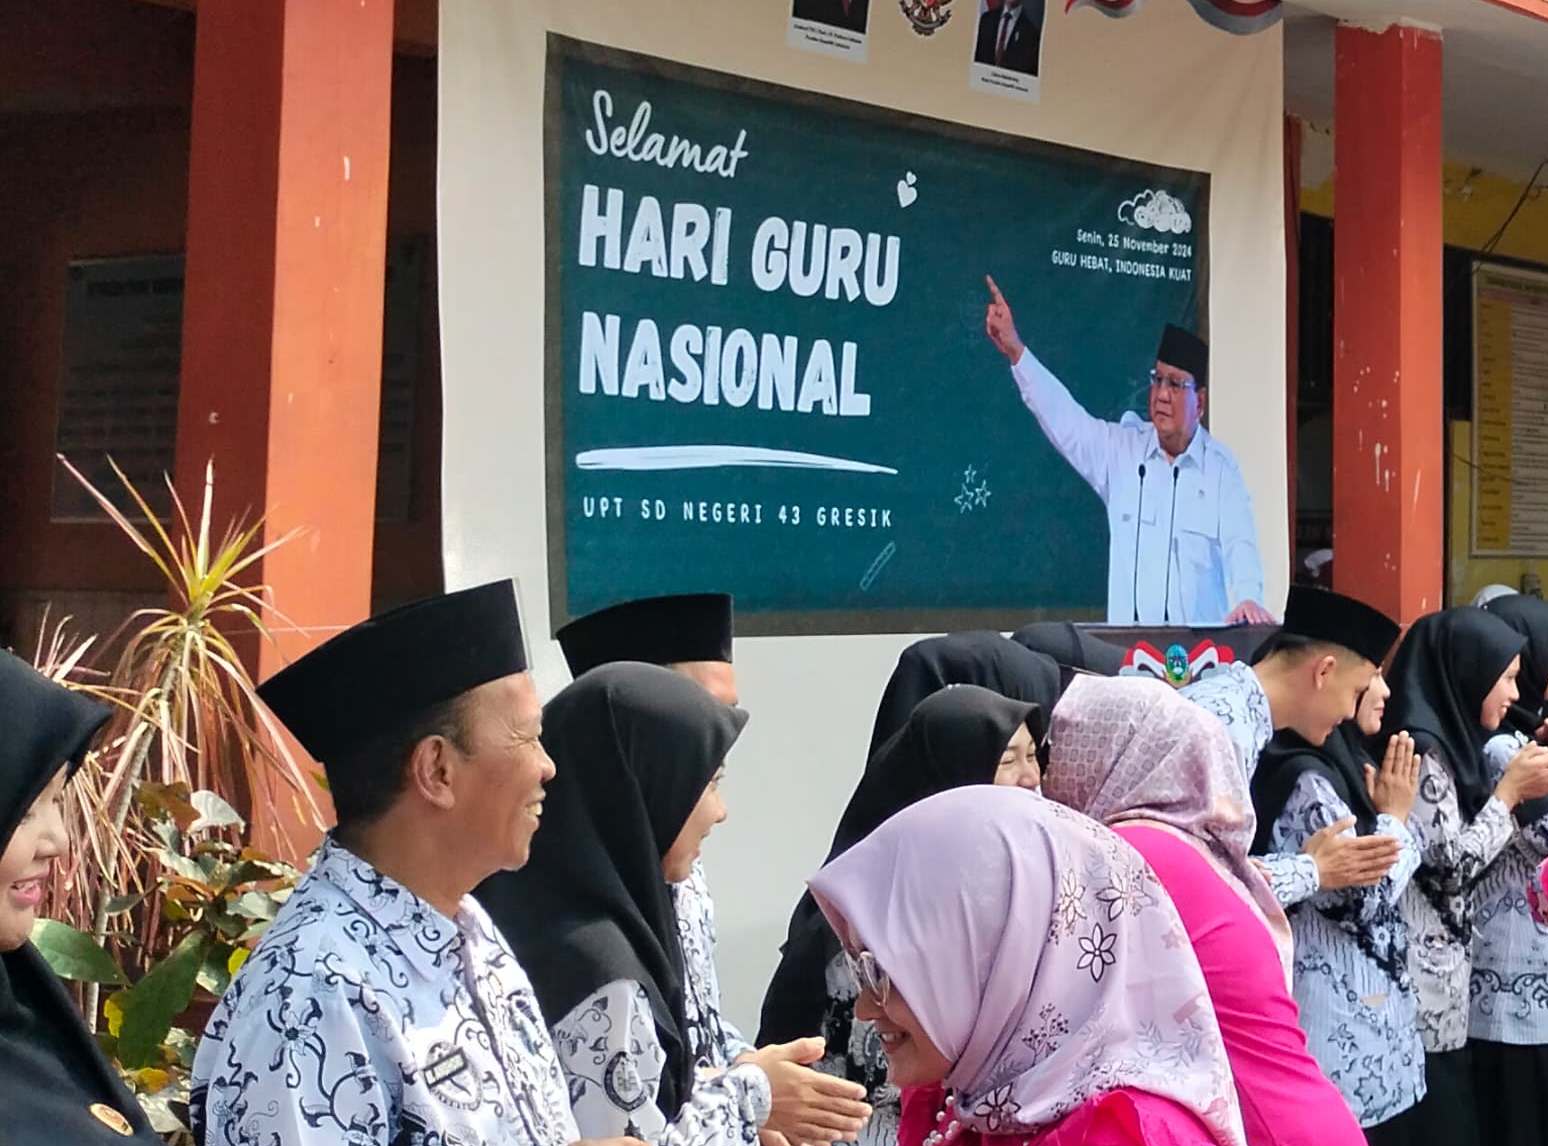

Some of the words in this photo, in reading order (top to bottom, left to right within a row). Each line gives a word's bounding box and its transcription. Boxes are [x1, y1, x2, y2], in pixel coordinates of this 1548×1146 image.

[586, 90, 748, 178] Selamat
[578, 184, 732, 286] HARI
[751, 216, 901, 307] GURU
[1052, 250, 1077, 266] GURU
[1080, 254, 1113, 273] HEBAT,
[1116, 259, 1166, 278] INDONESIA
[1168, 267, 1192, 281] KUAT
[1076, 229, 1105, 247] Senin,
[1108, 234, 1119, 248] 25
[1123, 237, 1169, 255] November
[1172, 243, 1192, 258] 2024
[578, 311, 872, 416] NASIONAL
[583, 496, 624, 519] UPT
[640, 499, 666, 522] SD
[683, 501, 763, 524] NEGERI
[778, 504, 802, 526] 43
[816, 506, 893, 528] GRESIK
